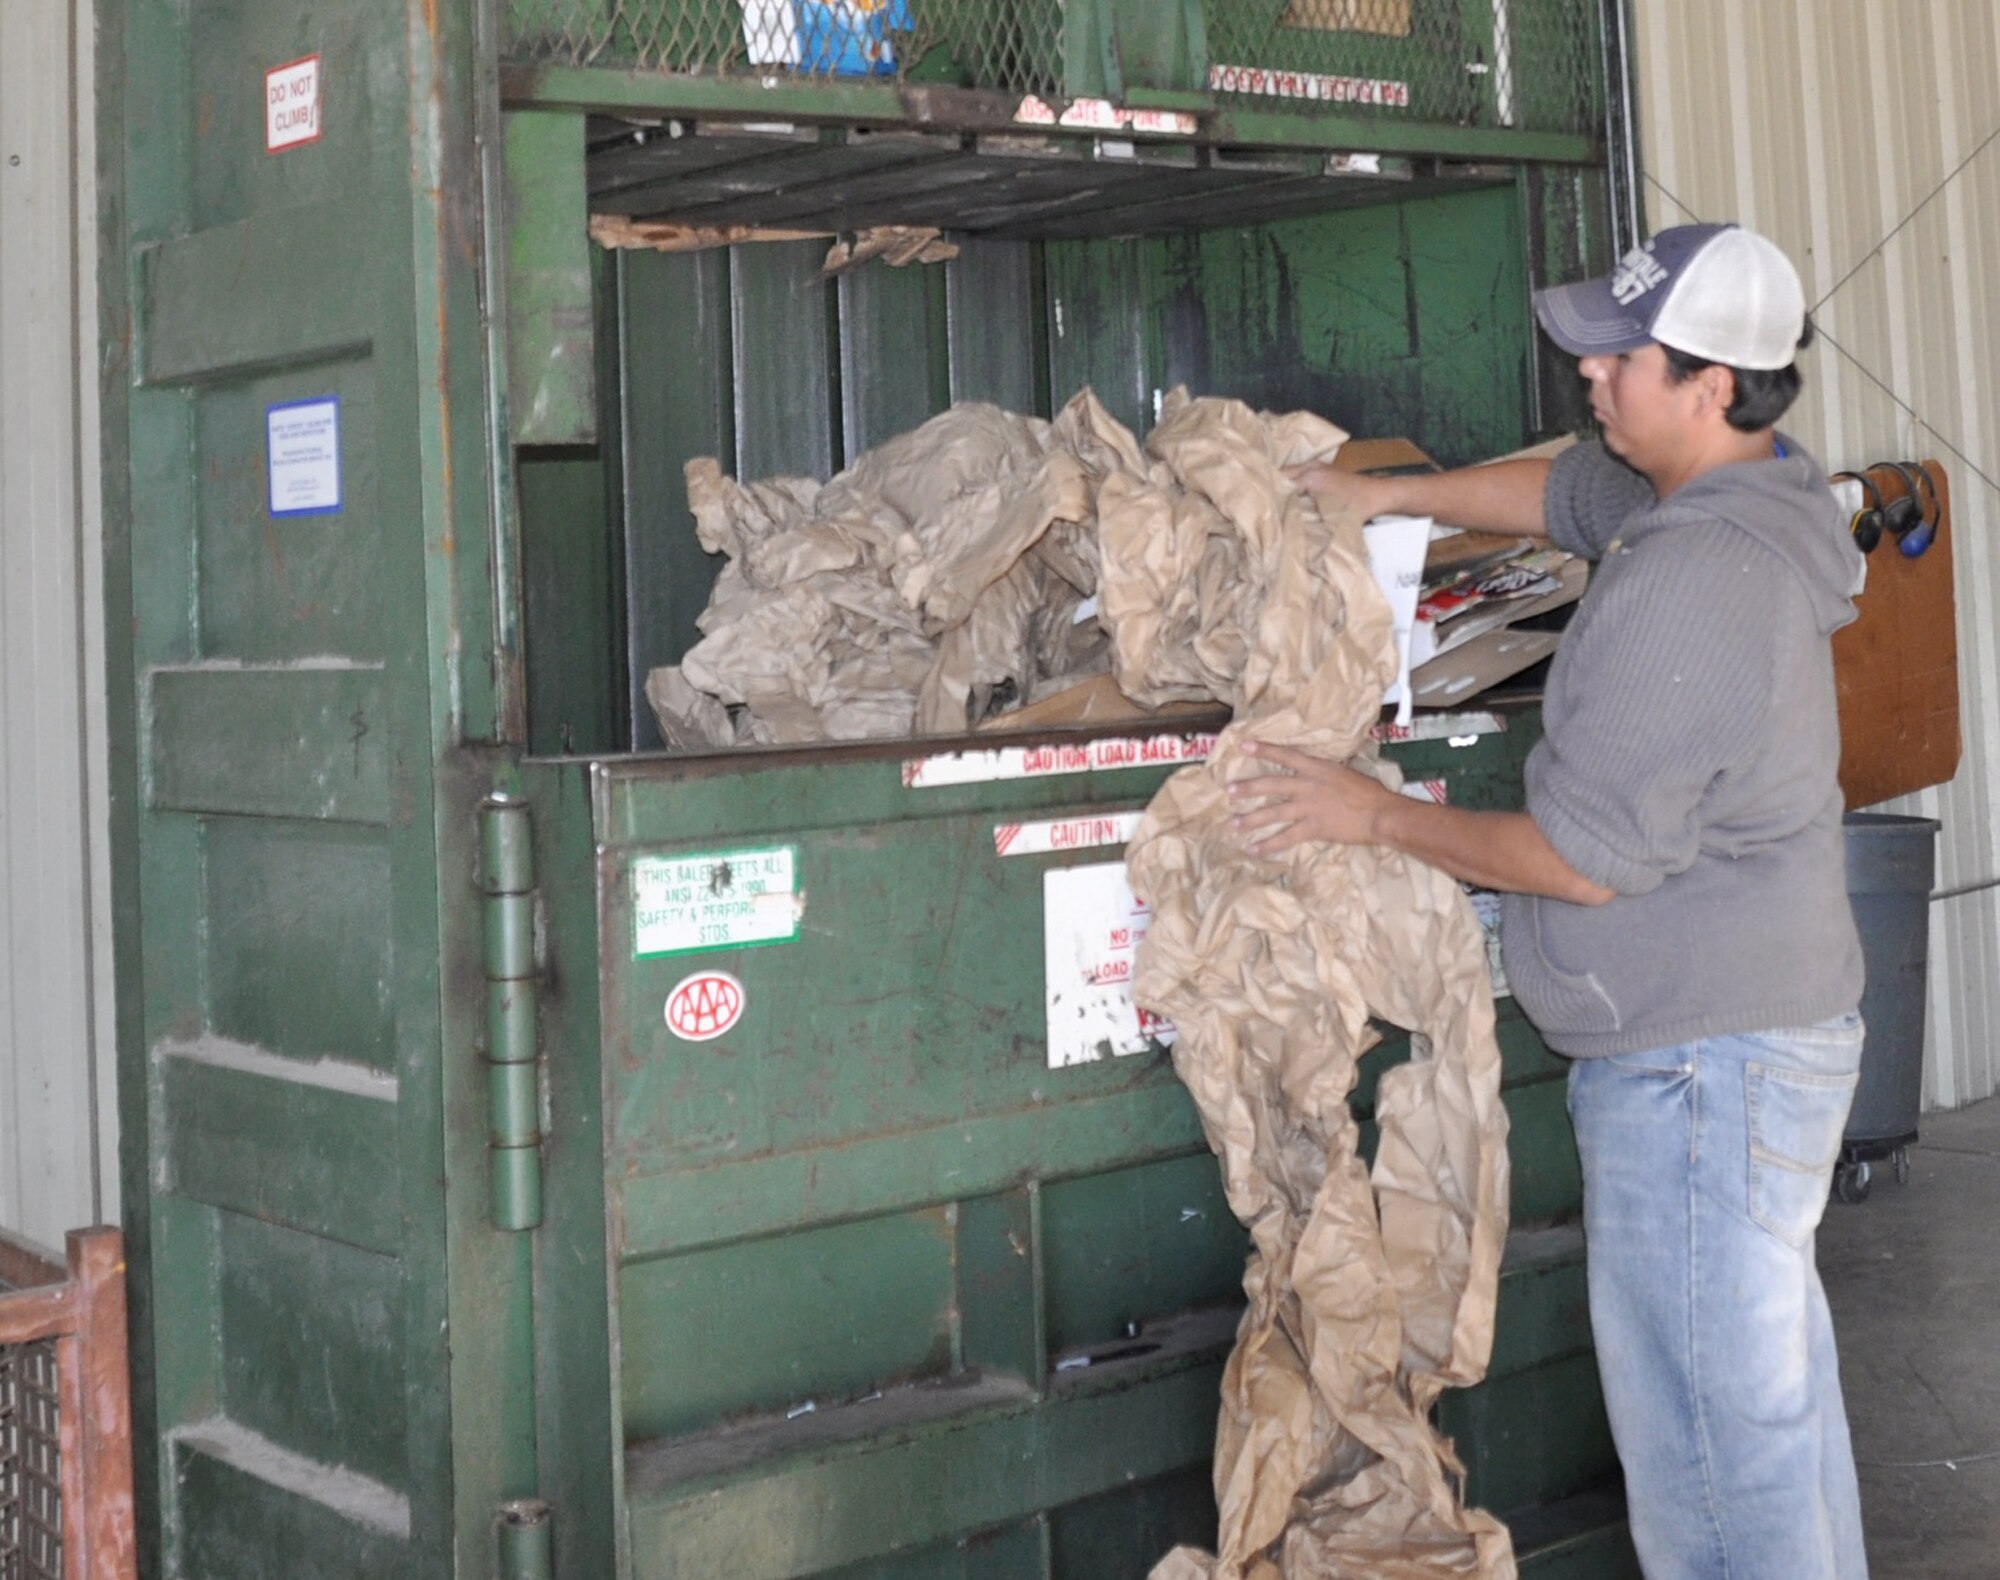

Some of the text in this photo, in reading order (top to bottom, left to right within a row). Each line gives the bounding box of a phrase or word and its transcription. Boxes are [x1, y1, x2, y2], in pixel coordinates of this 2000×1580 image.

[269, 75, 312, 105] DO NOT
[275, 105, 309, 130] CLIMB
[1097, 741, 1136, 766] LOAD
[1141, 738, 1176, 762] BALE
[643, 868, 671, 887] THIS
[764, 856, 783, 874] ALL
[638, 908, 685, 928] SAFETY
[1110, 928, 1128, 946] NO
[1095, 960, 1128, 980] LOAD
[671, 978, 738, 1033] AAA
